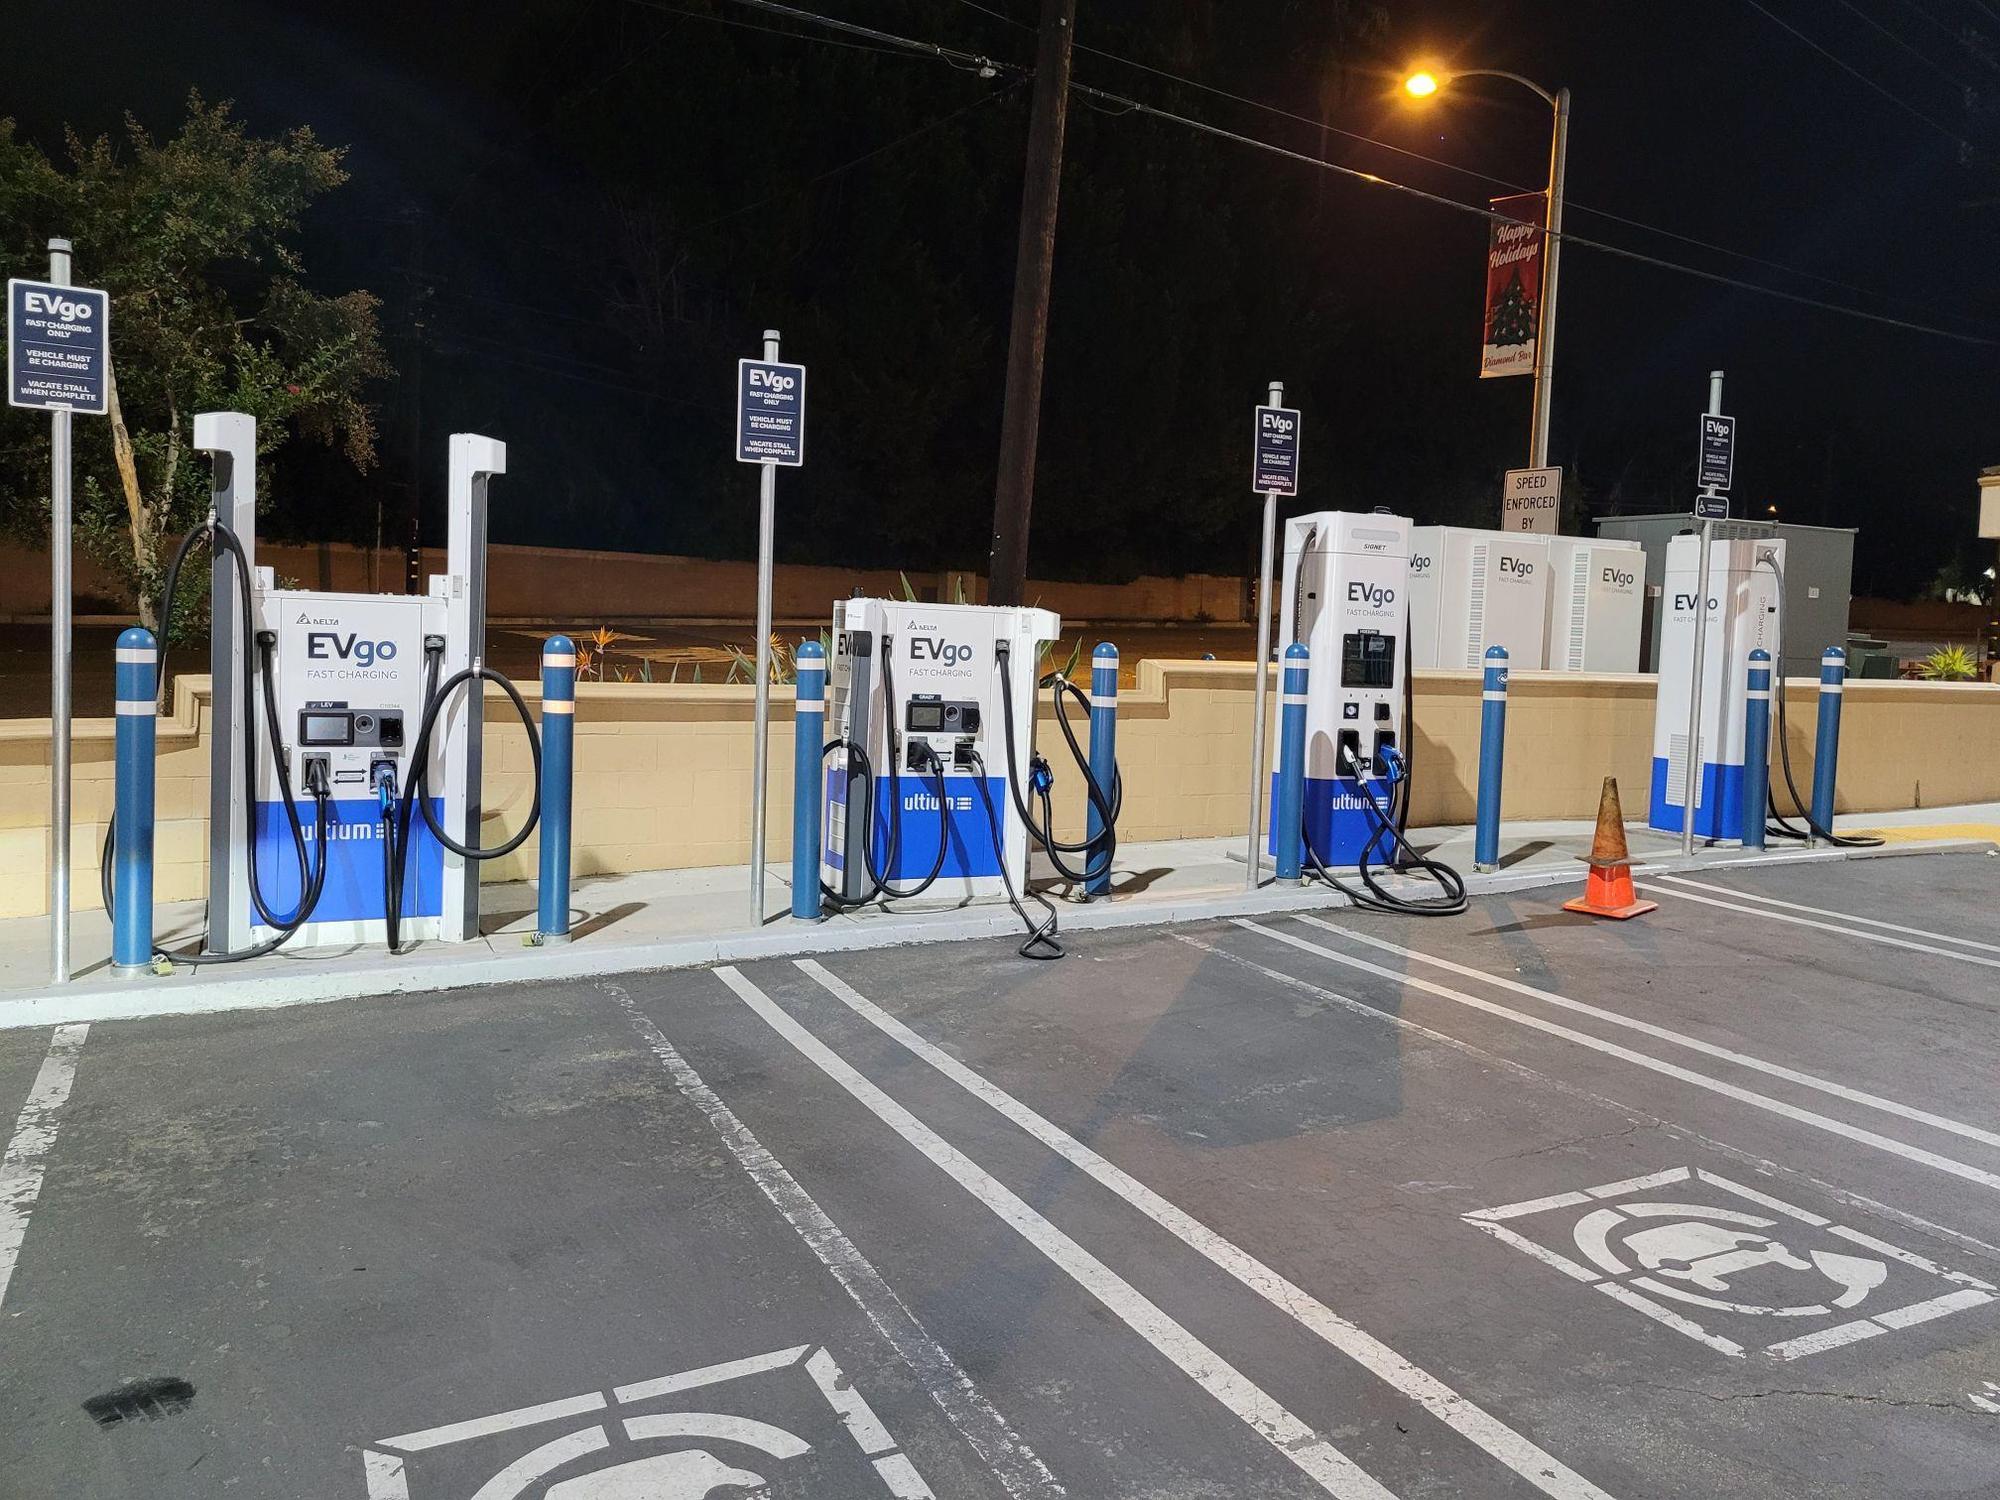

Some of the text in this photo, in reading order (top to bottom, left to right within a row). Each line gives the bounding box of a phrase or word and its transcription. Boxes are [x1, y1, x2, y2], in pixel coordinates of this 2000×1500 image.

[1497, 221, 1535, 243] Happy
[1490, 243, 1538, 268] Holidays
[25, 292, 92, 322] EVgo
[25, 319, 92, 333] FAST CHARGING
[47, 330, 71, 338] ONLY
[26, 349, 92, 362] VEHICLE MUST
[1484, 352, 1517, 368] Diamond
[42, 359, 89, 370] CHARGING
[28, 380, 90, 393] VACATE STALL
[749, 369, 795, 392] EVgo
[21, 387, 97, 402] WHEN COMPLETE
[763, 392, 794, 401] CHARGING
[749, 416, 793, 425] VEHICLE MUST
[759, 423, 791, 431] CHARGING
[1263, 414, 1293, 433] EVgo
[1706, 420, 1729, 437] EVgo
[749, 440, 773, 448] VACATE
[763, 447, 796, 456] COMPLETE
[1516, 475, 1547, 490] SPEED
[1506, 496, 1556, 511] ENFORCED
[1521, 517, 1535, 530] BY
[1363, 543, 1387, 551] SIGNET
[1410, 553, 1431, 572] Vgo
[1500, 556, 1534, 578] EVgo
[1602, 568, 1634, 587] EVgo
[1347, 581, 1395, 608] EVgo
[1675, 594, 1718, 610] EVo
[1346, 608, 1395, 618] FAST CHARGING
[1756, 596, 1767, 647] CHARGING
[308, 632, 398, 668] EVgo
[910, 637, 973, 668] EVgo
[307, 670, 398, 679] FAST CHARGING
[909, 668, 973, 678] FAST CHARGING
